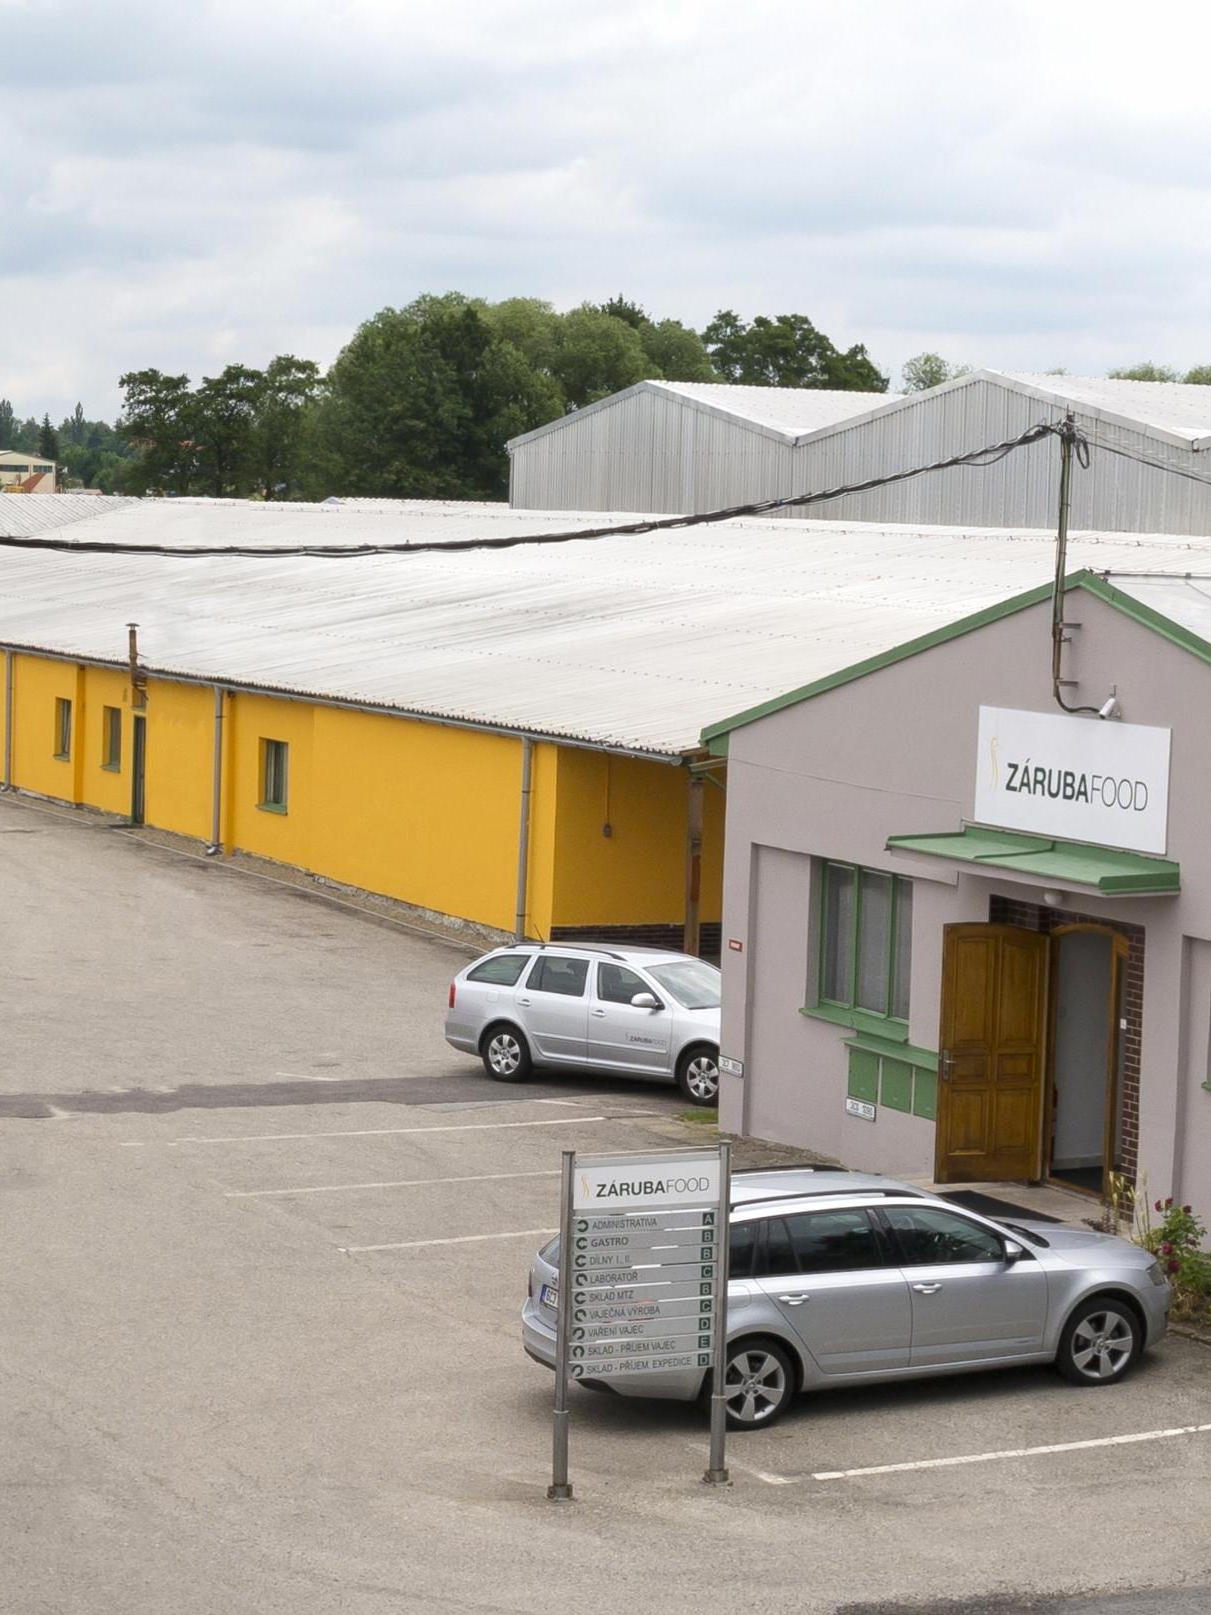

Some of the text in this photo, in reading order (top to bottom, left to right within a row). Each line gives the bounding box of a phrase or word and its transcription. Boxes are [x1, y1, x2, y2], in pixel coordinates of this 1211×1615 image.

[1005, 758, 1148, 811] ZÁRUBAFOOD
[596, 1177, 710, 1198] ZÁRUBAFOOD
[592, 1214, 712, 1230] ADMINISTRATIVA A
[591, 1231, 711, 1248] GASTRO B
[703, 1248, 710, 1258] B
[703, 1267, 711, 1277] C
[589, 1285, 709, 1302] SKLAD MTZ B
[702, 1302, 710, 1311] C
[619, 1325, 644, 1335] VAJEC
[701, 1320, 708, 1329] D
[588, 1345, 614, 1356] SKLAD
[651, 1340, 676, 1350] VAJEC
[701, 1337, 708, 1347] E
[586, 1363, 613, 1374] SKLAD
[652, 1357, 692, 1368] EXPEDICE
[700, 1355, 707, 1365] D
